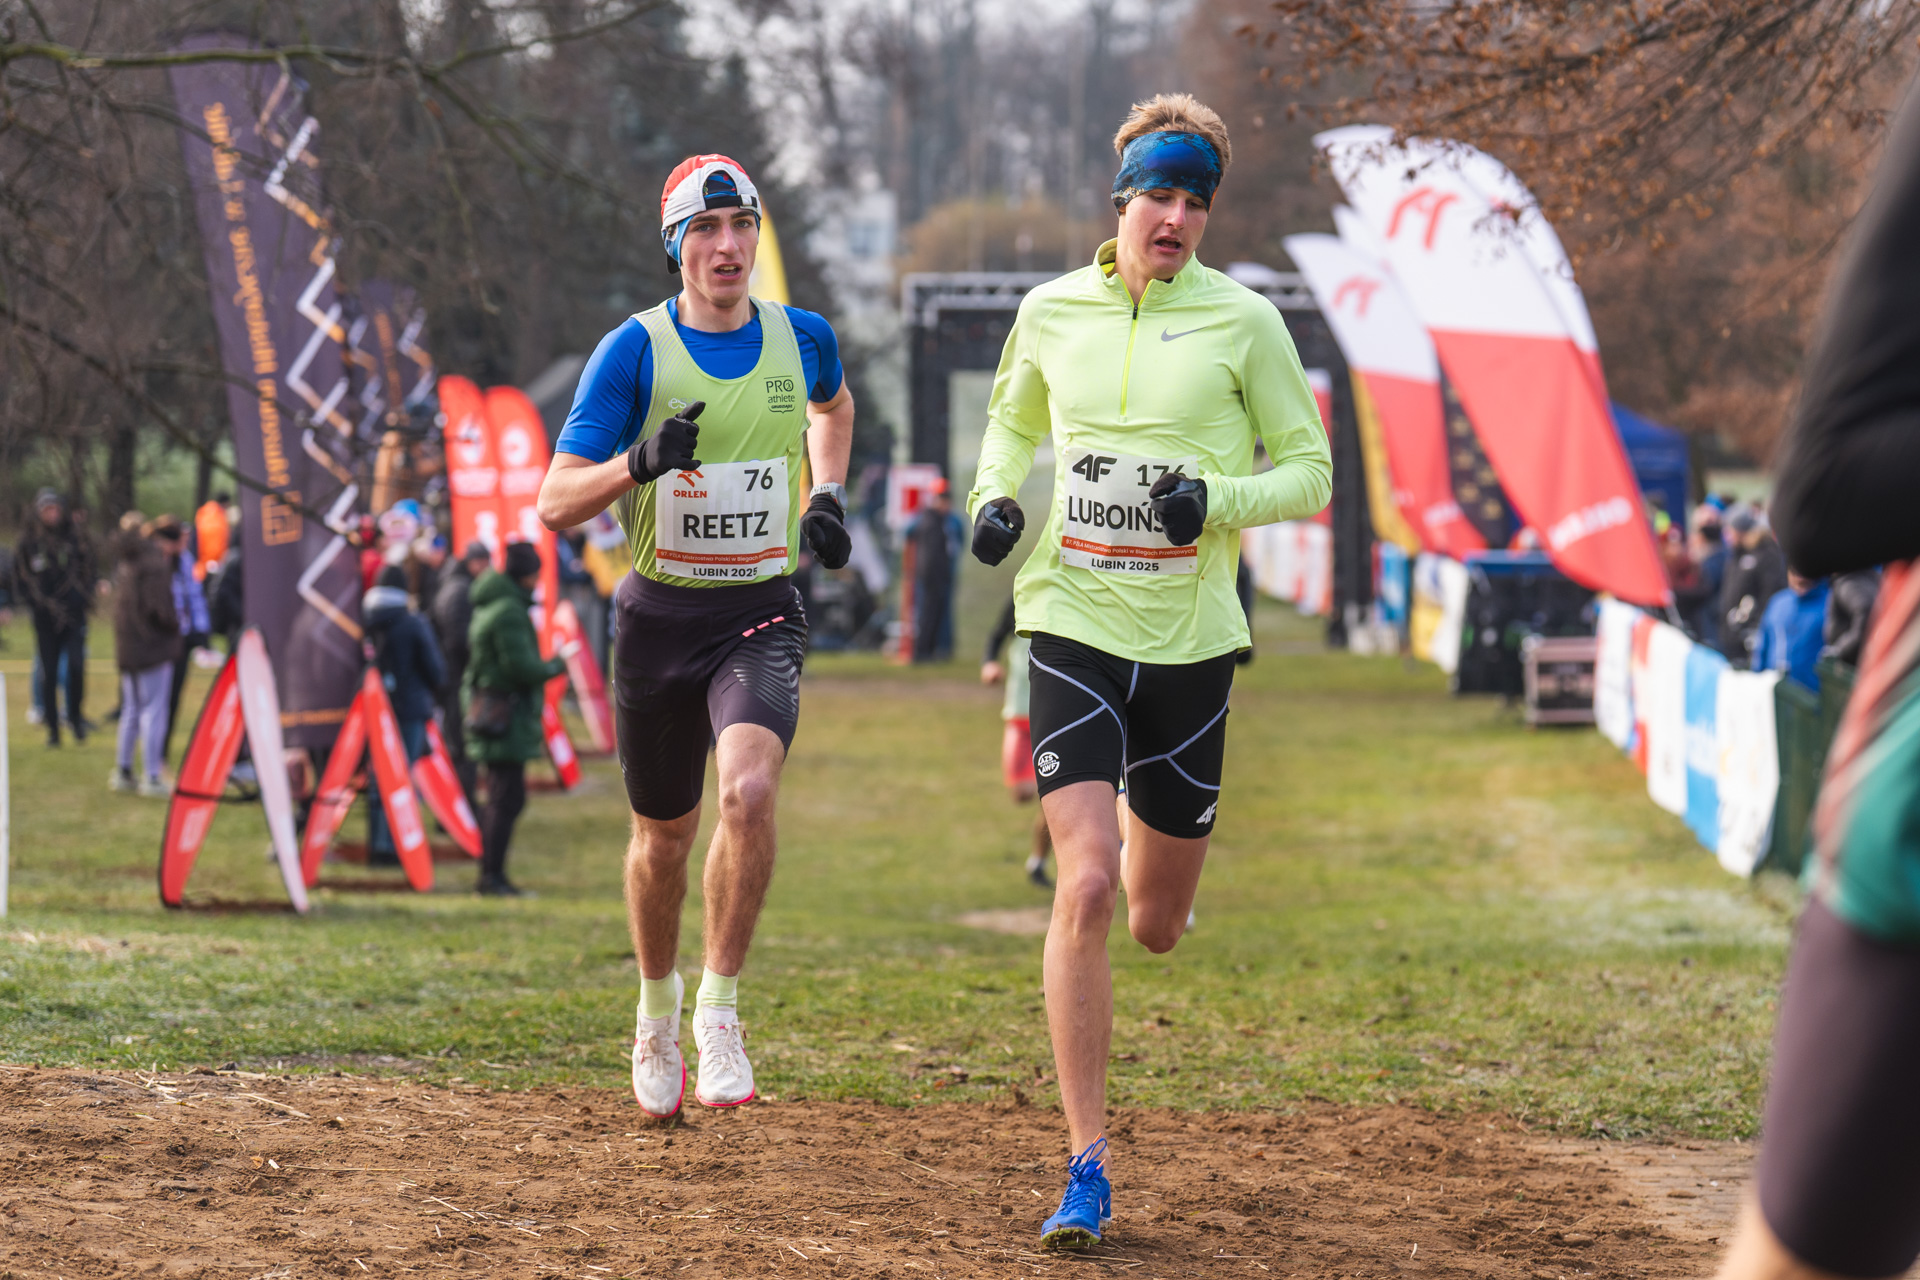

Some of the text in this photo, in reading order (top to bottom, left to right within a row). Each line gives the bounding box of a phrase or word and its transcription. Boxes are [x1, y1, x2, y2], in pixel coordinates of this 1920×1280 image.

[766, 379, 794, 393] PRO
[768, 394, 795, 404] athlete
[1072, 454, 1118, 483] 4F
[744, 467, 774, 492] 76
[673, 489, 708, 499] ORLEN
[683, 511, 769, 539] REETZ
[1159, 548, 1195, 556] Przełajowych
[682, 554, 714, 562] Mistrzostwa
[737, 555, 759, 563] Biegach
[1091, 558, 1160, 572] LUBIN 2025
[693, 566, 758, 577] LUBIN 2025
